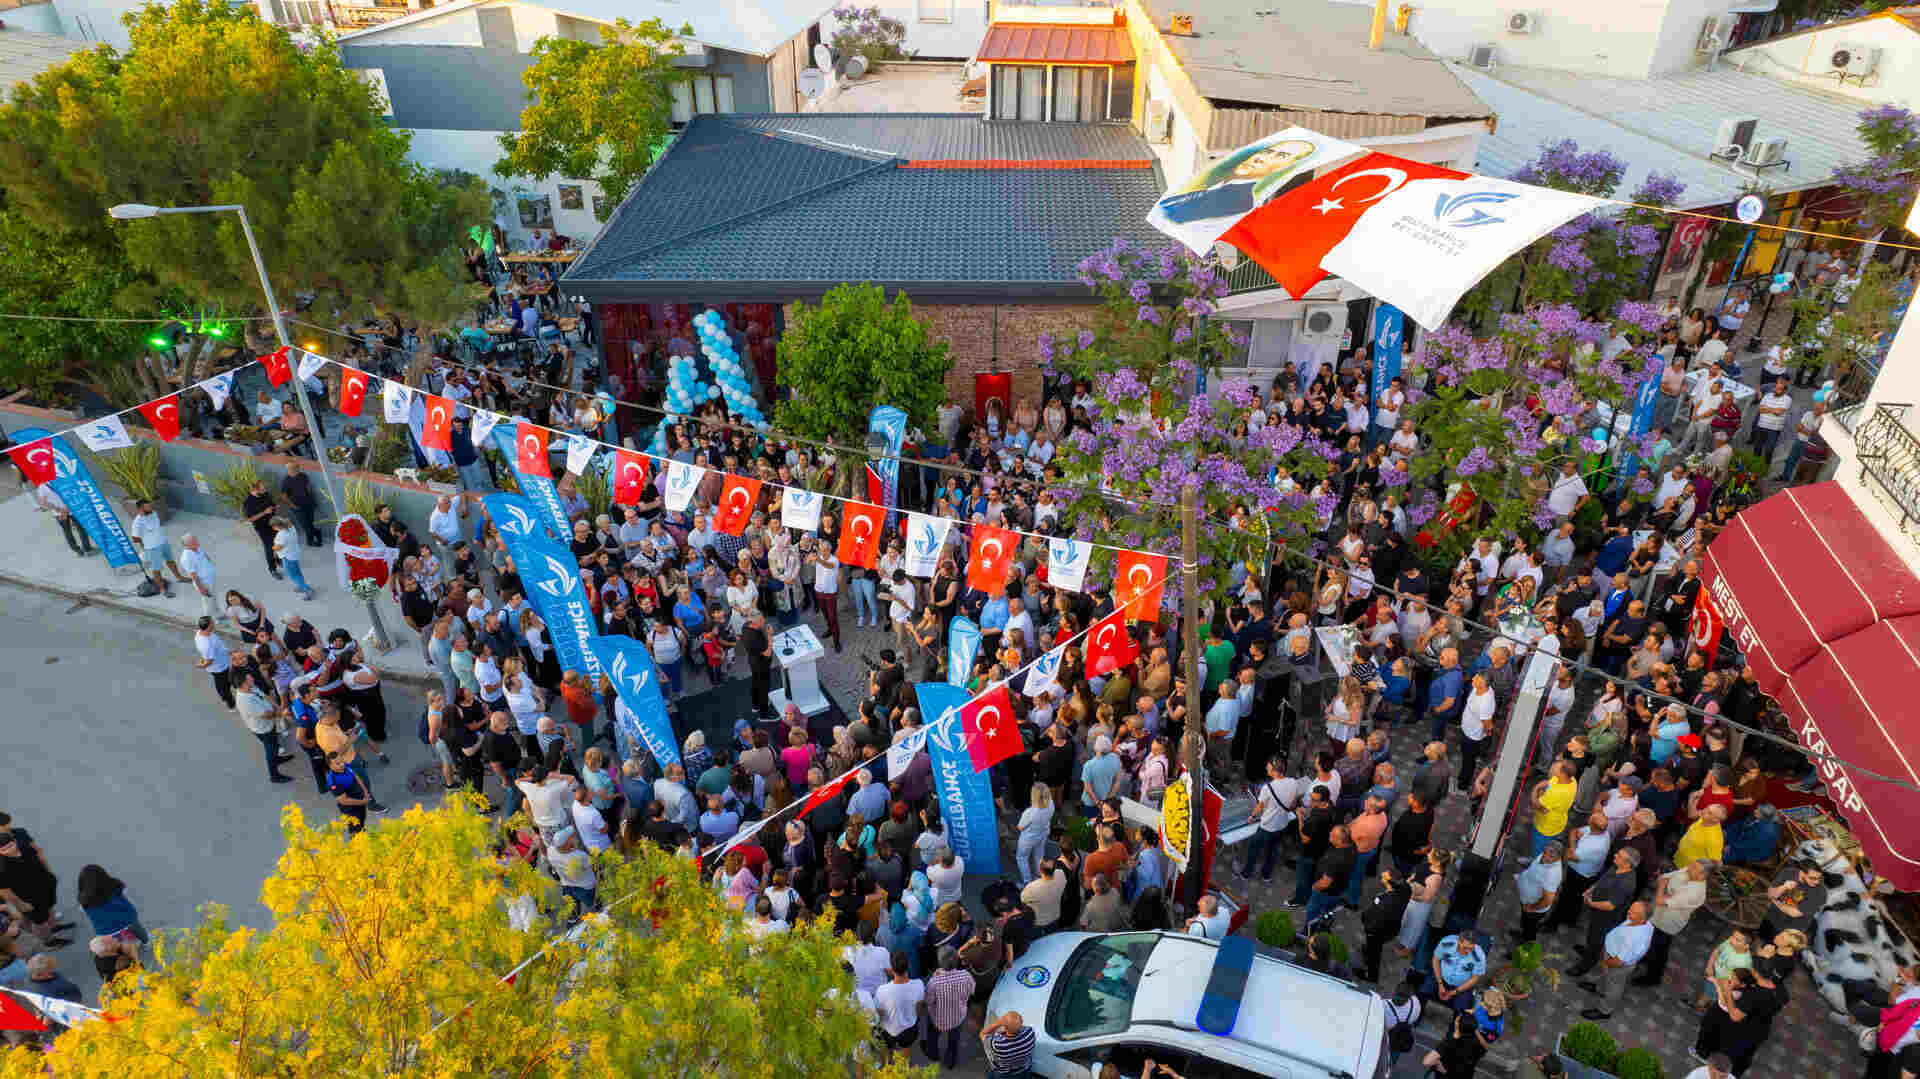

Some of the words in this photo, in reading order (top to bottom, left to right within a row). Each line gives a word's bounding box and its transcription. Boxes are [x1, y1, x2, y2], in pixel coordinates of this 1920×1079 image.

[1712, 575, 1742, 624] MEST
[1740, 624, 1758, 652] ET
[1801, 719, 1861, 812] KASAP
